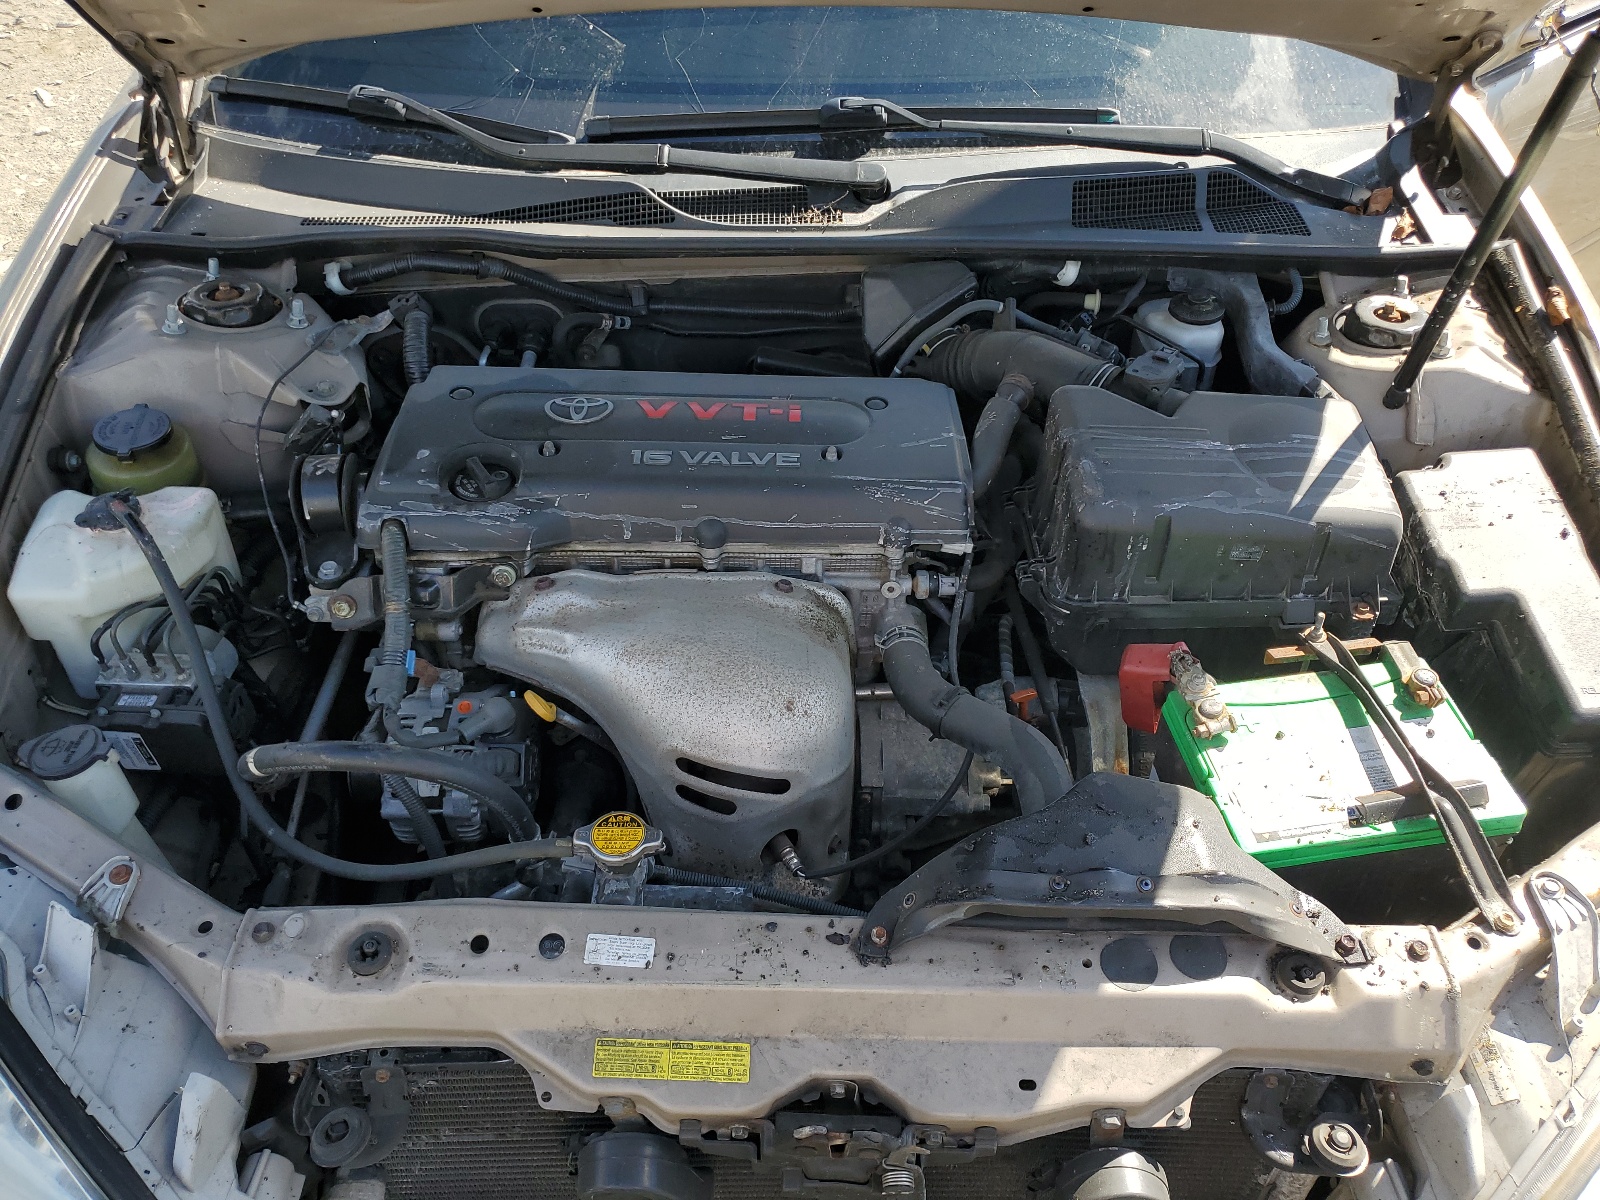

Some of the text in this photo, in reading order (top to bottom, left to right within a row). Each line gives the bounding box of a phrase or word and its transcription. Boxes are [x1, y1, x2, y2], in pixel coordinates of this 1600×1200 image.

[636, 400, 801, 422] VVT-i
[631, 449, 800, 466] 16 VALVE
